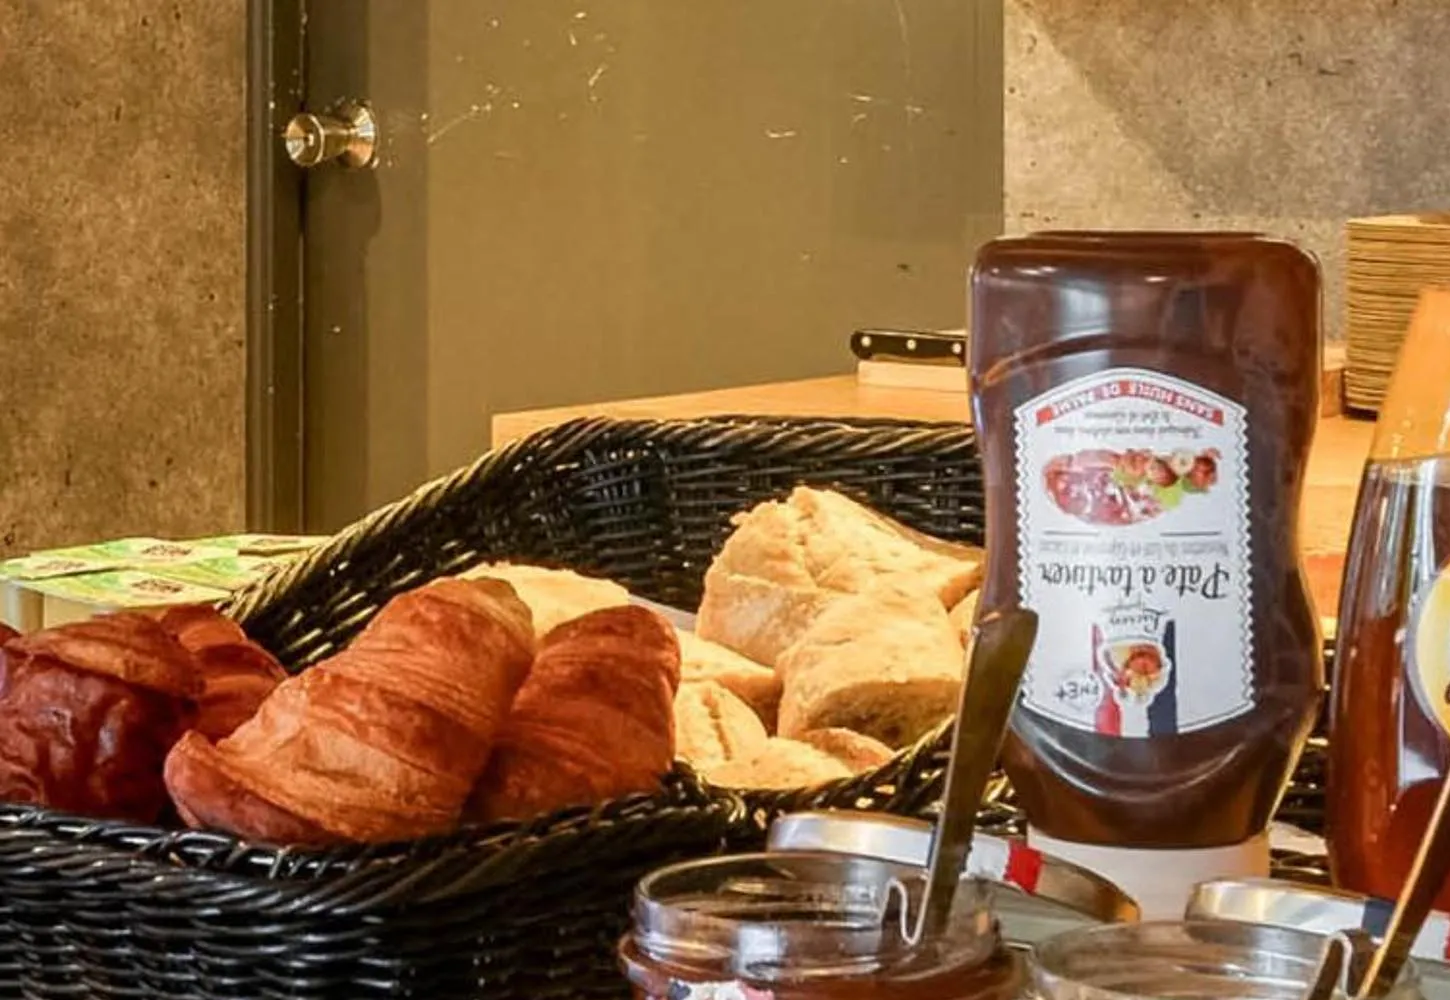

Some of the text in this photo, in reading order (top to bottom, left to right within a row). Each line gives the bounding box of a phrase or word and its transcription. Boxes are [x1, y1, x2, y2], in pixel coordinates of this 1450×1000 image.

[1039, 563, 1230, 599] Pâte à tartiner
